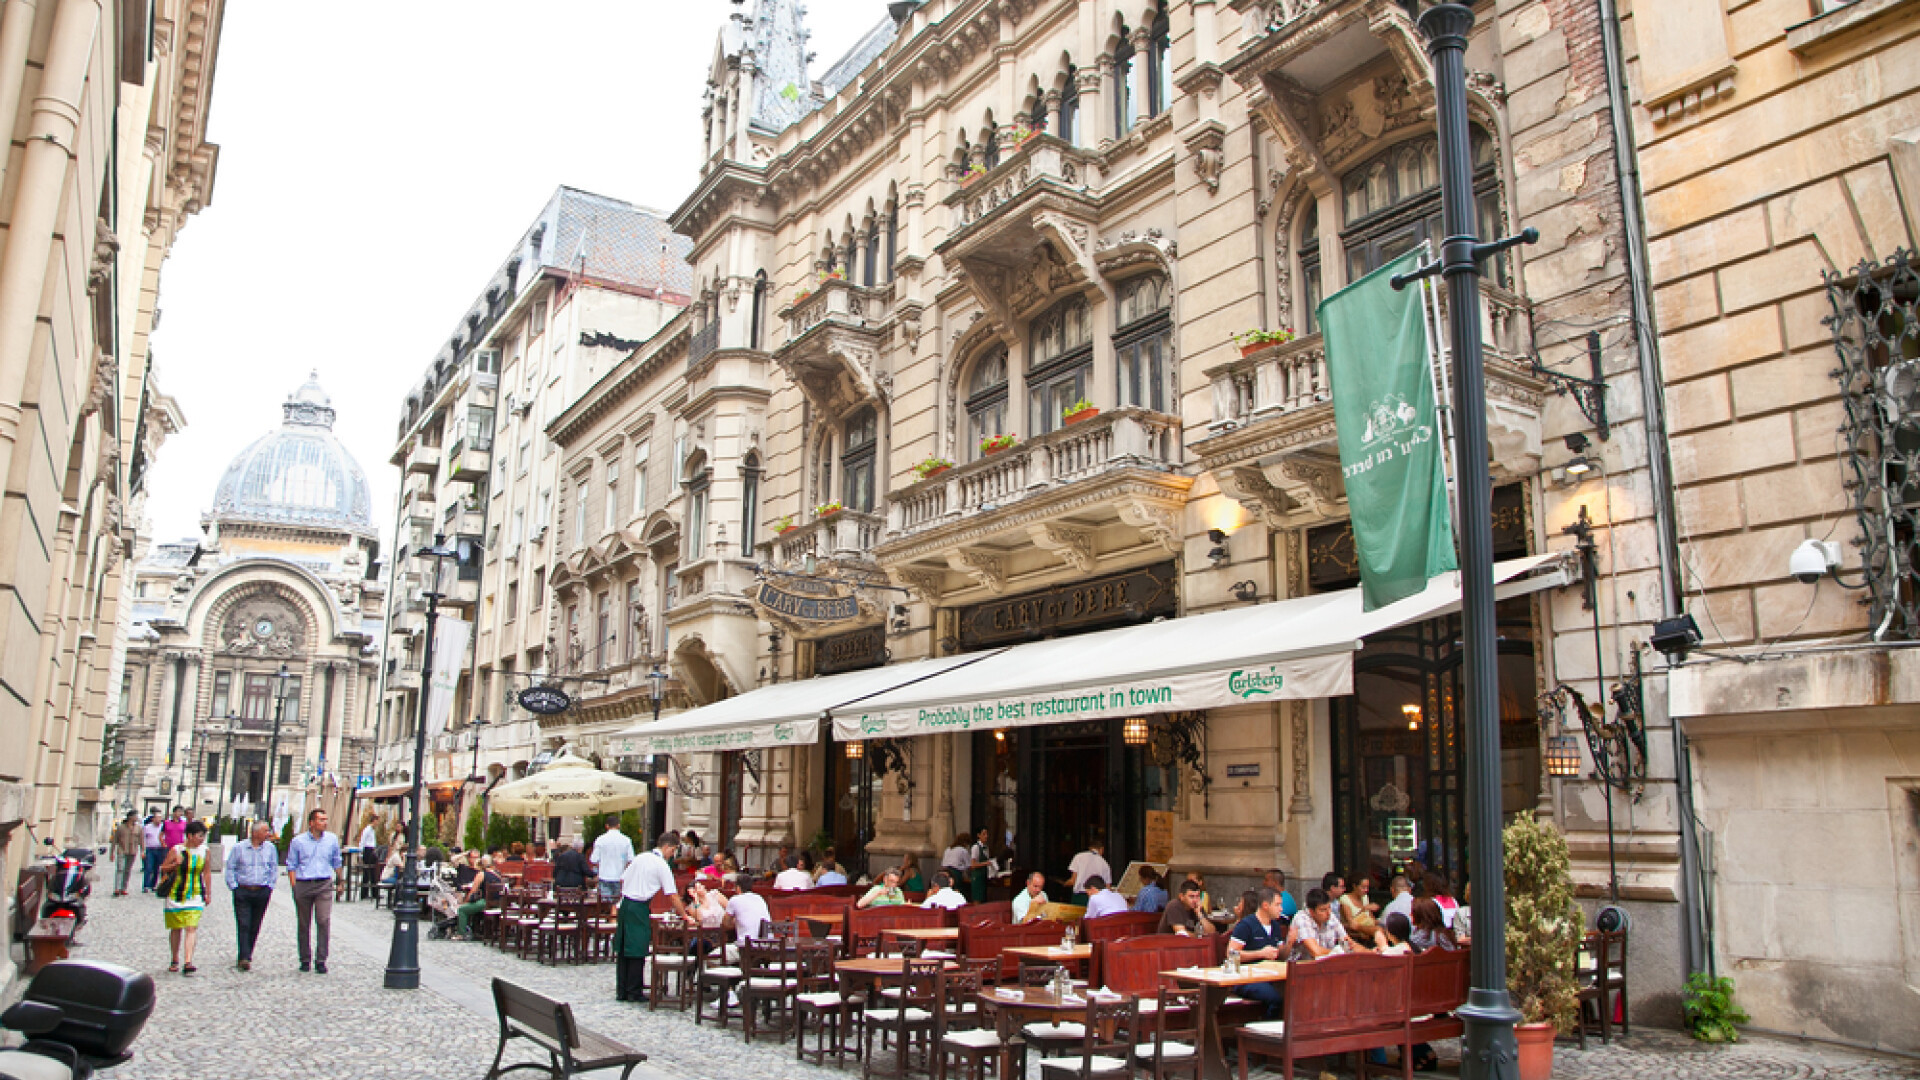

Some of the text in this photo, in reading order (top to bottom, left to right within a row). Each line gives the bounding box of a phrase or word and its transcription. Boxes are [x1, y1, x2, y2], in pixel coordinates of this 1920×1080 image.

[1072, 580, 1130, 617] BERE
[1228, 665, 1283, 699] Carlsberg
[918, 686, 1172, 729] Probably the best restaurant in town
